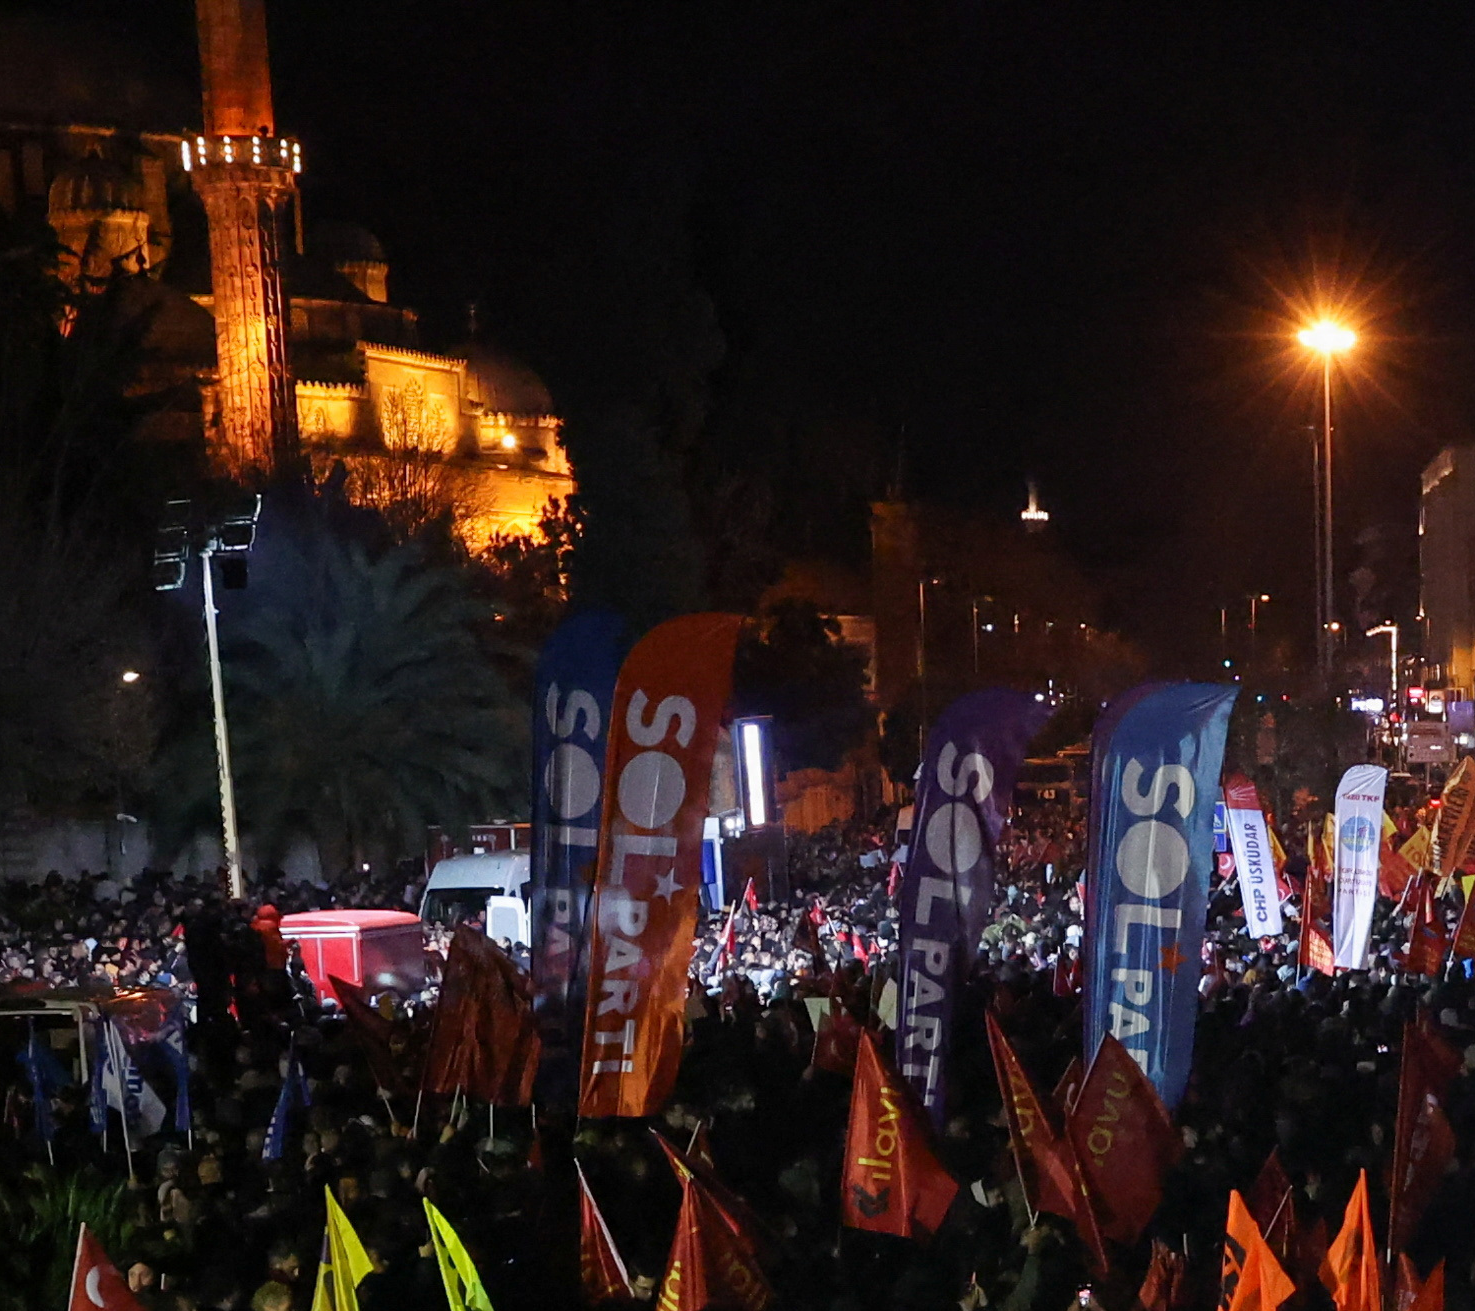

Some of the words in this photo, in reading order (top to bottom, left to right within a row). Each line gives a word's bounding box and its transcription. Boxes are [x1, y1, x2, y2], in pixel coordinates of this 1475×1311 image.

[610, 687, 697, 888] SOL
[912, 741, 995, 925] SOL
[1115, 756, 1196, 955] SOL
[1243, 822, 1263, 886] ÜSKÜDAR
[1254, 887, 1269, 923] CHP
